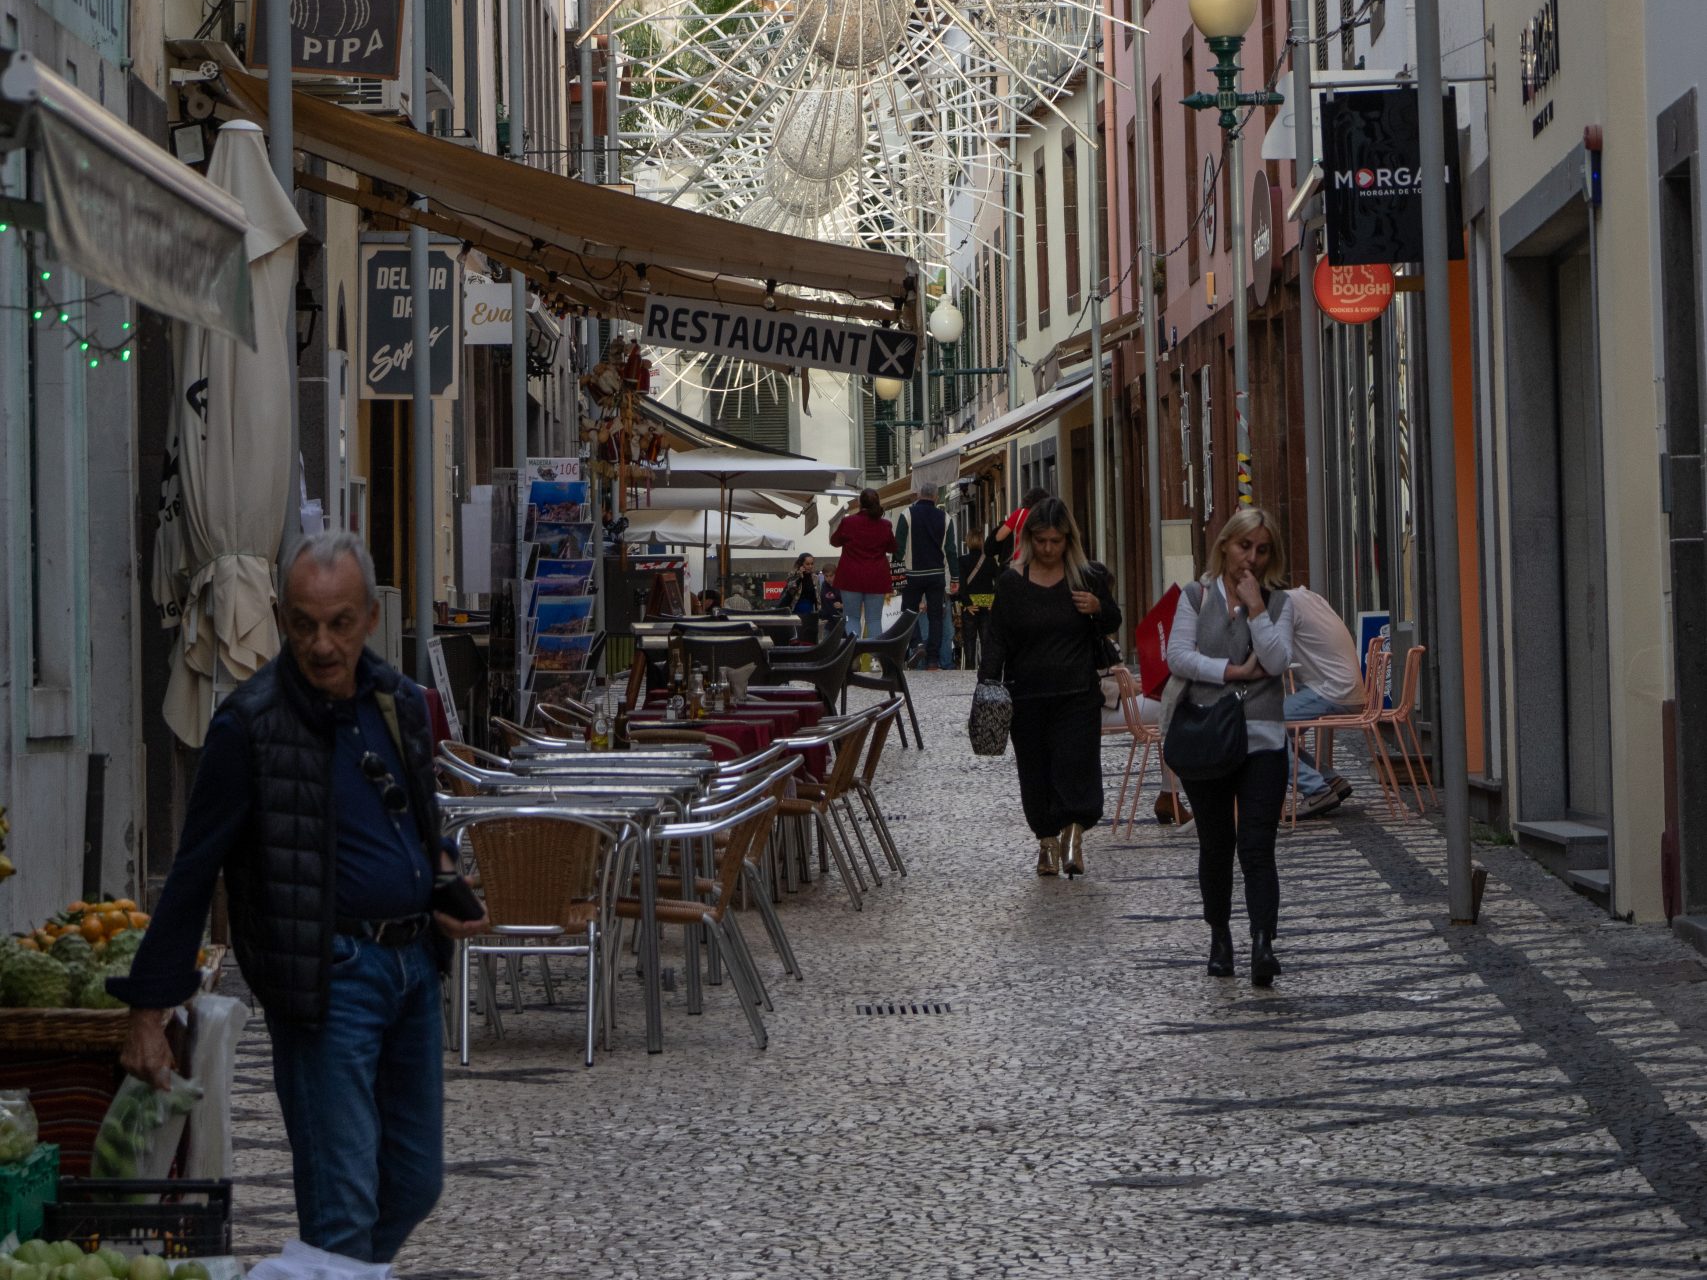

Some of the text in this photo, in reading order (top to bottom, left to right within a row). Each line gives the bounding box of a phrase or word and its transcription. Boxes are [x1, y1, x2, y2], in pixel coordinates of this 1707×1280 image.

[302, 28, 384, 64] PIPA
[1359, 189, 1395, 197] MORGAN
[1412, 187, 1422, 195] TO
[376, 266, 448, 290] DELIA
[1332, 272, 1354, 285] MY
[1332, 283, 1391, 296] DOUGH!
[392, 295, 413, 319] DA
[1329, 306, 1354, 314] COOKIES
[647, 303, 867, 367] RESTAURANT
[368, 324, 450, 383] Sops
[559, 463, 579, 476] 10€
